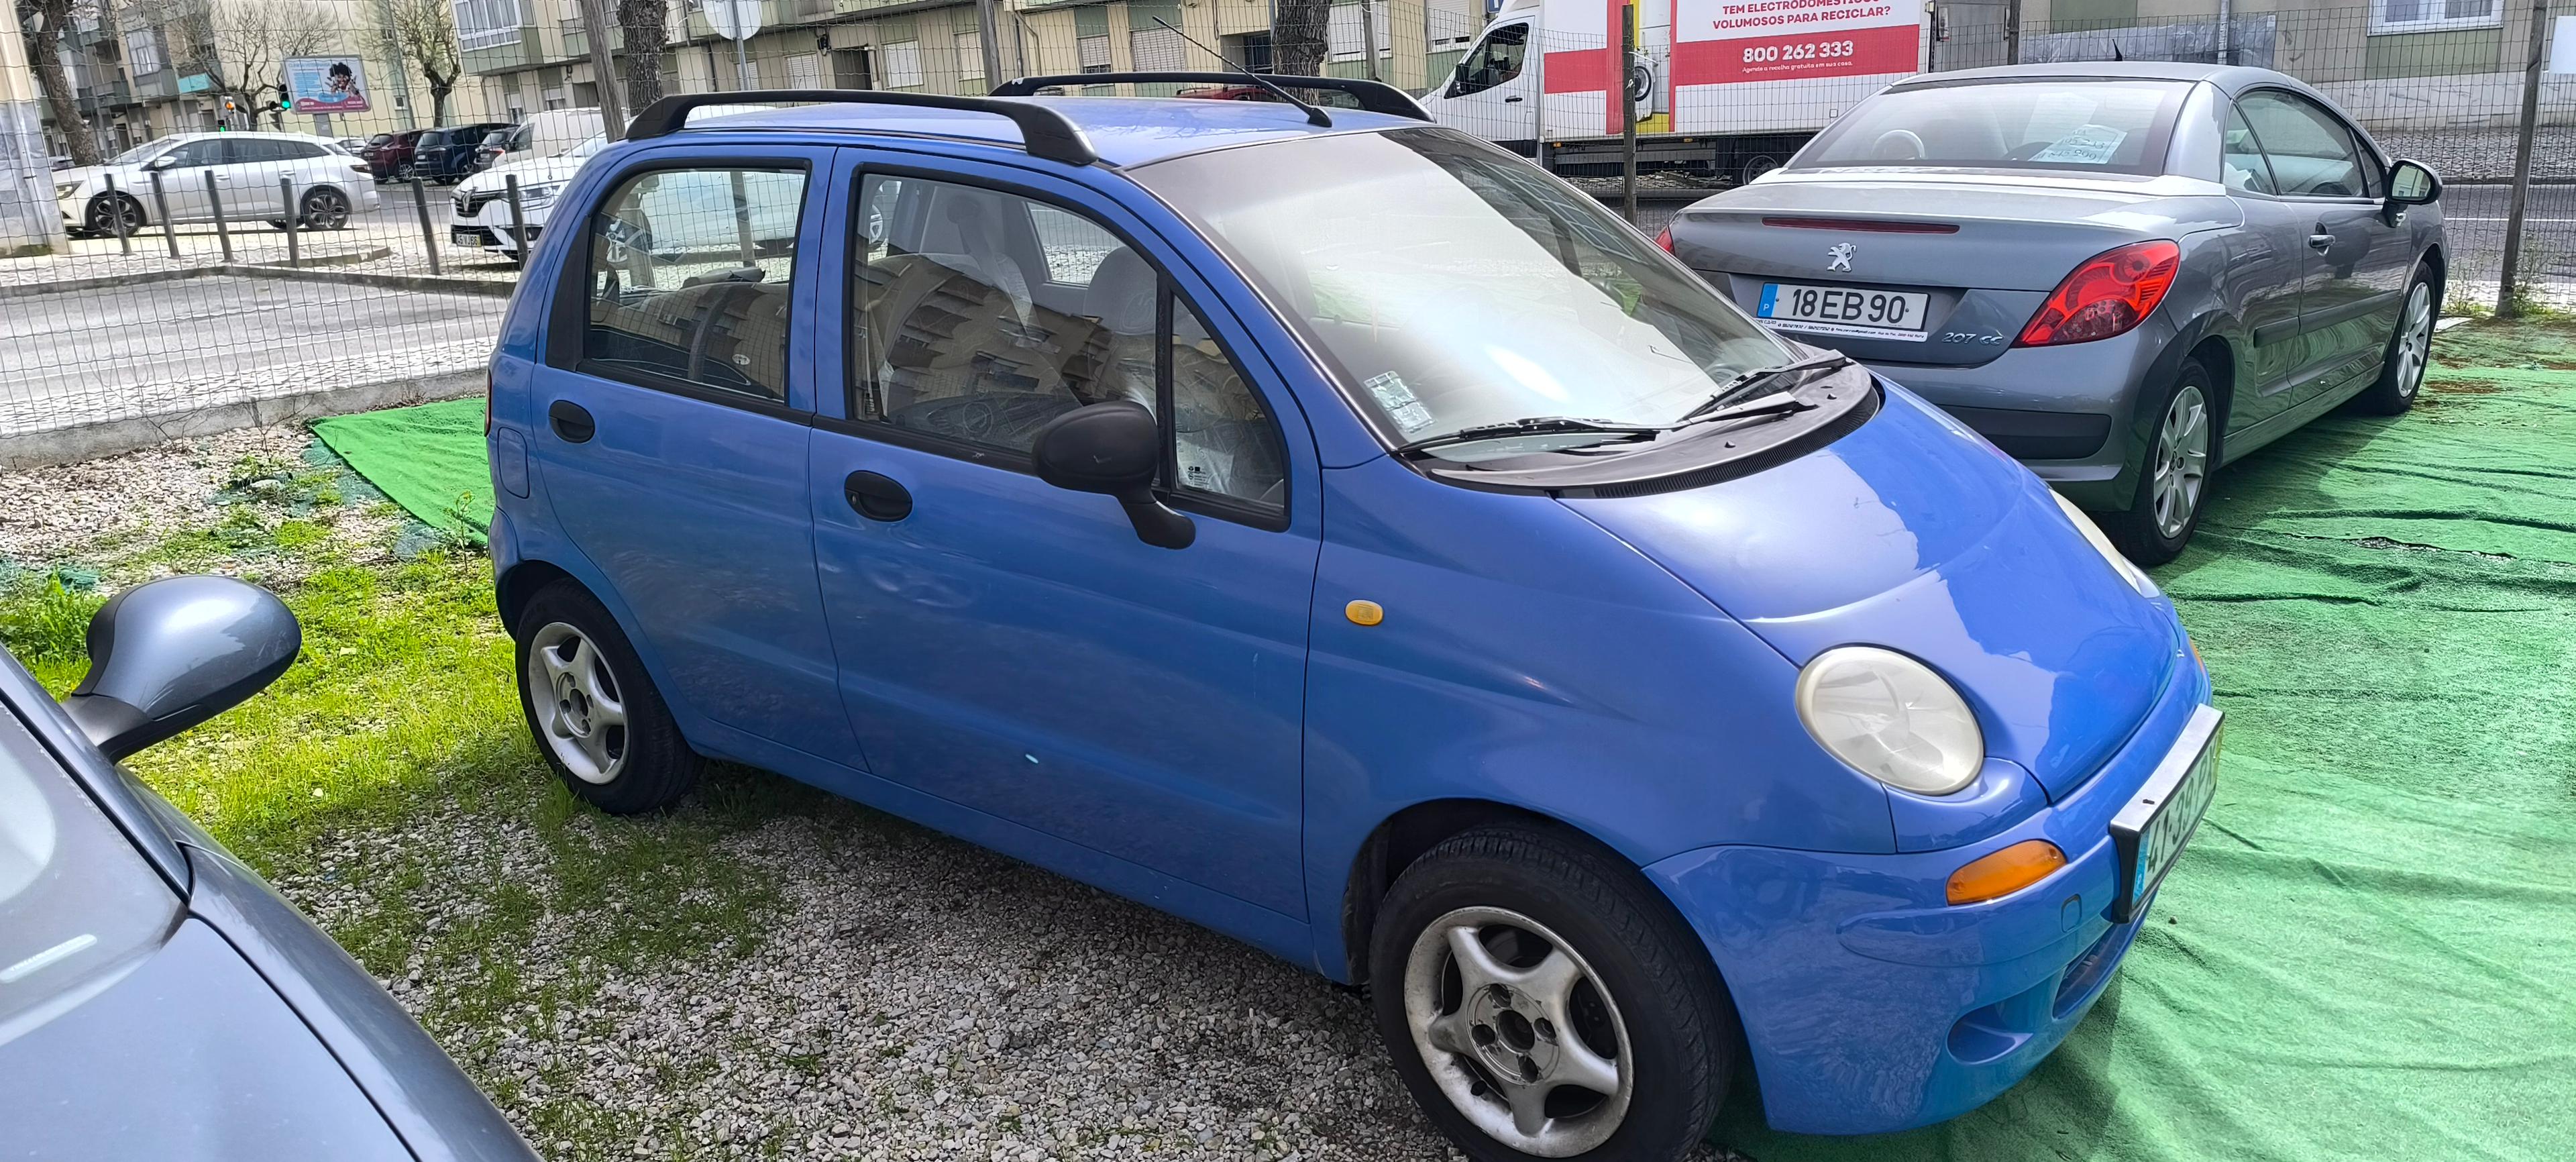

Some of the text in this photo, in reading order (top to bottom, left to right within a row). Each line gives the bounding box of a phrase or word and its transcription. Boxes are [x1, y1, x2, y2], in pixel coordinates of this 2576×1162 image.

[1713, 5, 1891, 30] VOLUMOSOS PARA RECICLAR?
[1723, 5, 1745, 15] TEM
[1743, 40, 1854, 62] 800 262 333
[1941, 332, 1976, 343] 207
